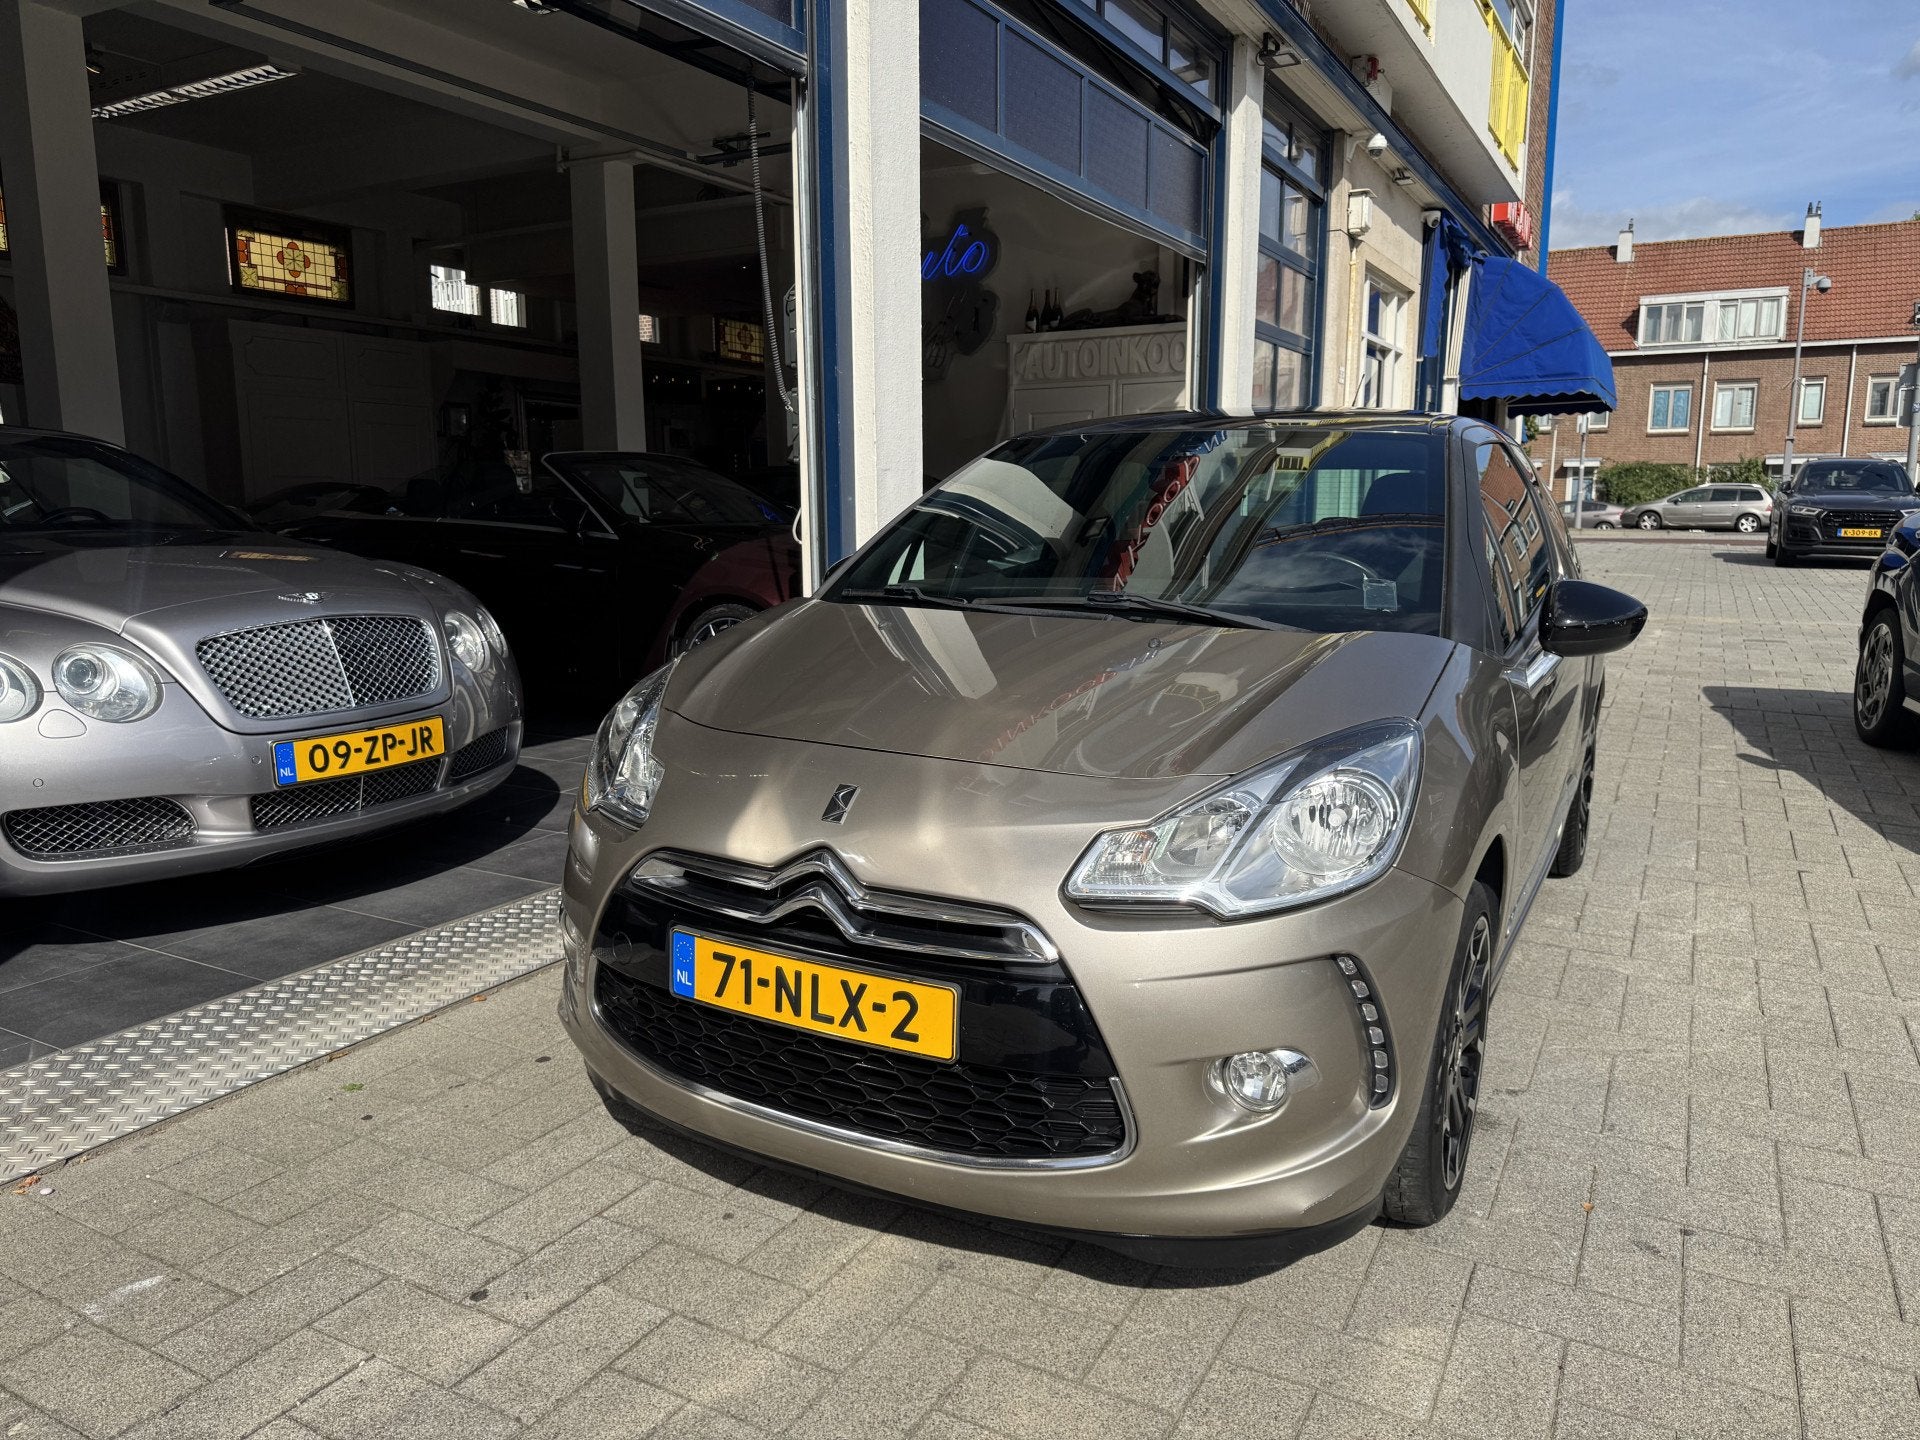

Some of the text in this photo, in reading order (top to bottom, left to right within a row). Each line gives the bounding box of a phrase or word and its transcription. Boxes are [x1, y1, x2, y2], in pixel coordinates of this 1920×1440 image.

[280, 725, 435, 777] NL 09-ZP-JR
[676, 951, 920, 1043] NL 71-NLX-2
